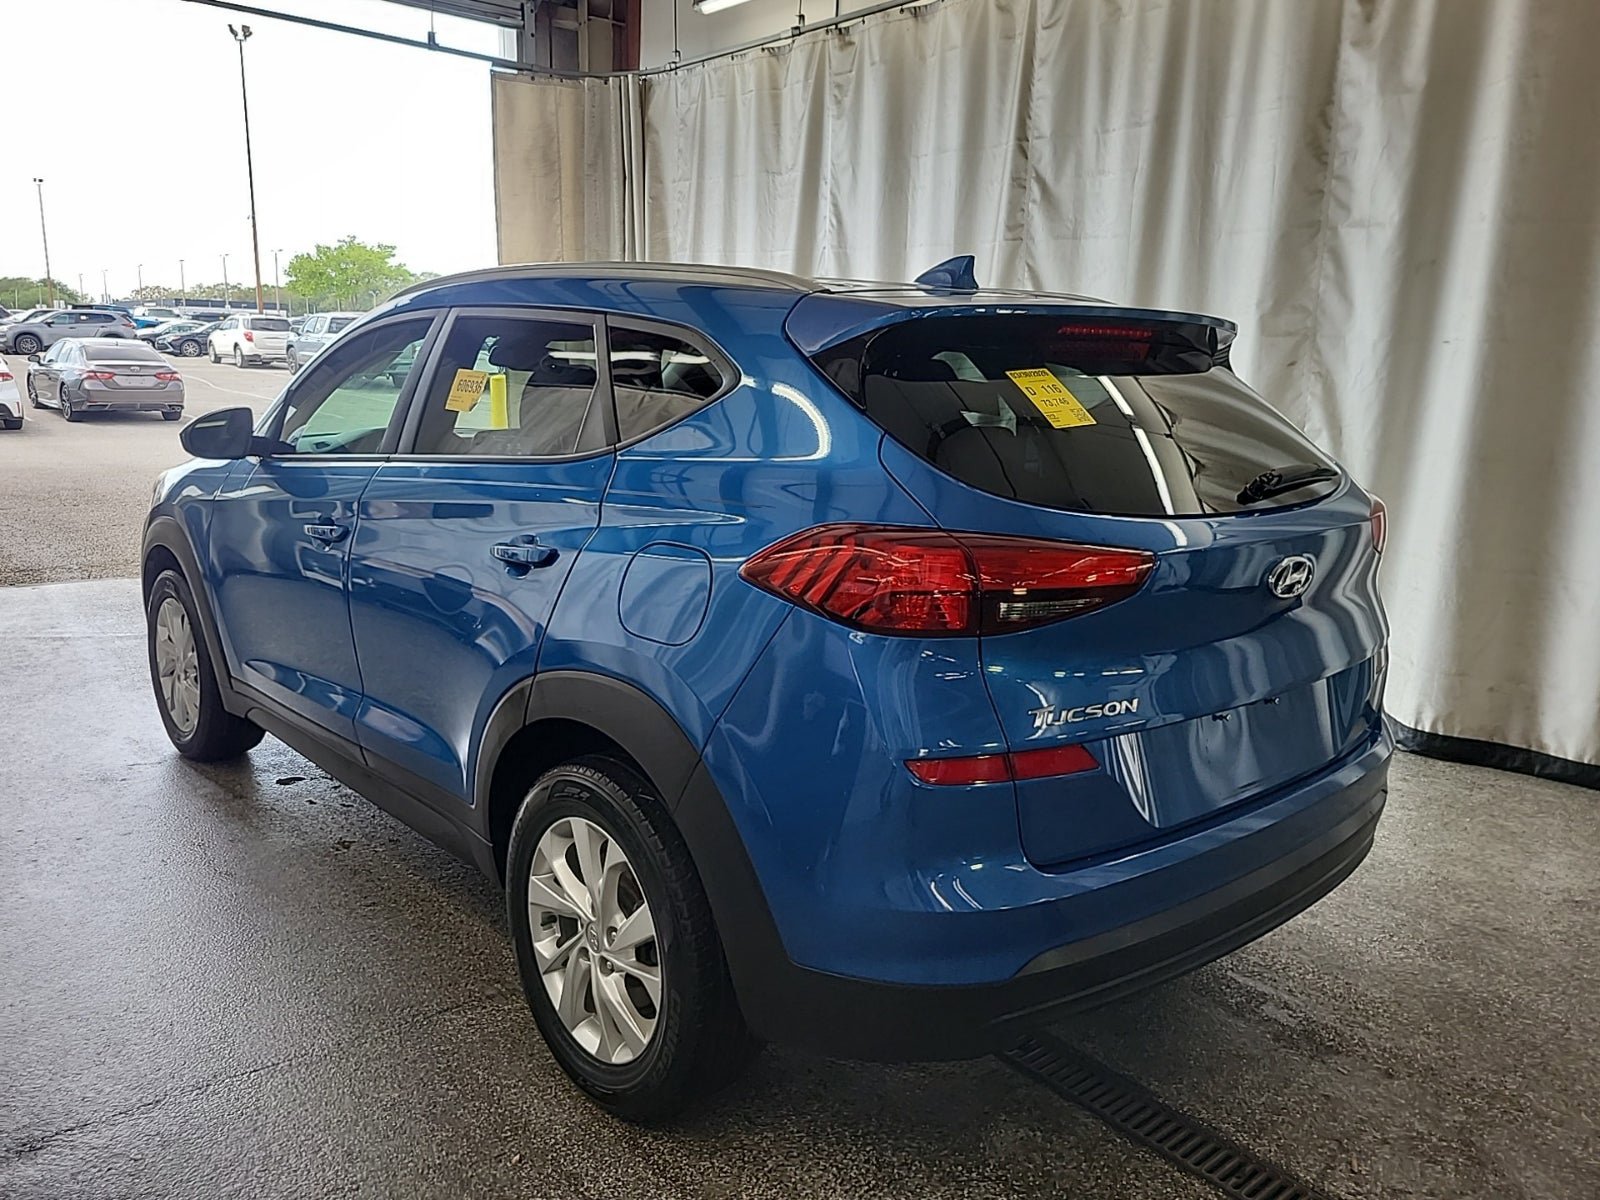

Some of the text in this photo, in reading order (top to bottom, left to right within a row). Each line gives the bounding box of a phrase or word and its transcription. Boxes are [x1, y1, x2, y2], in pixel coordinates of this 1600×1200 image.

[1024, 384, 1062, 396] D 116
[1028, 698, 1139, 729] TUCSON
